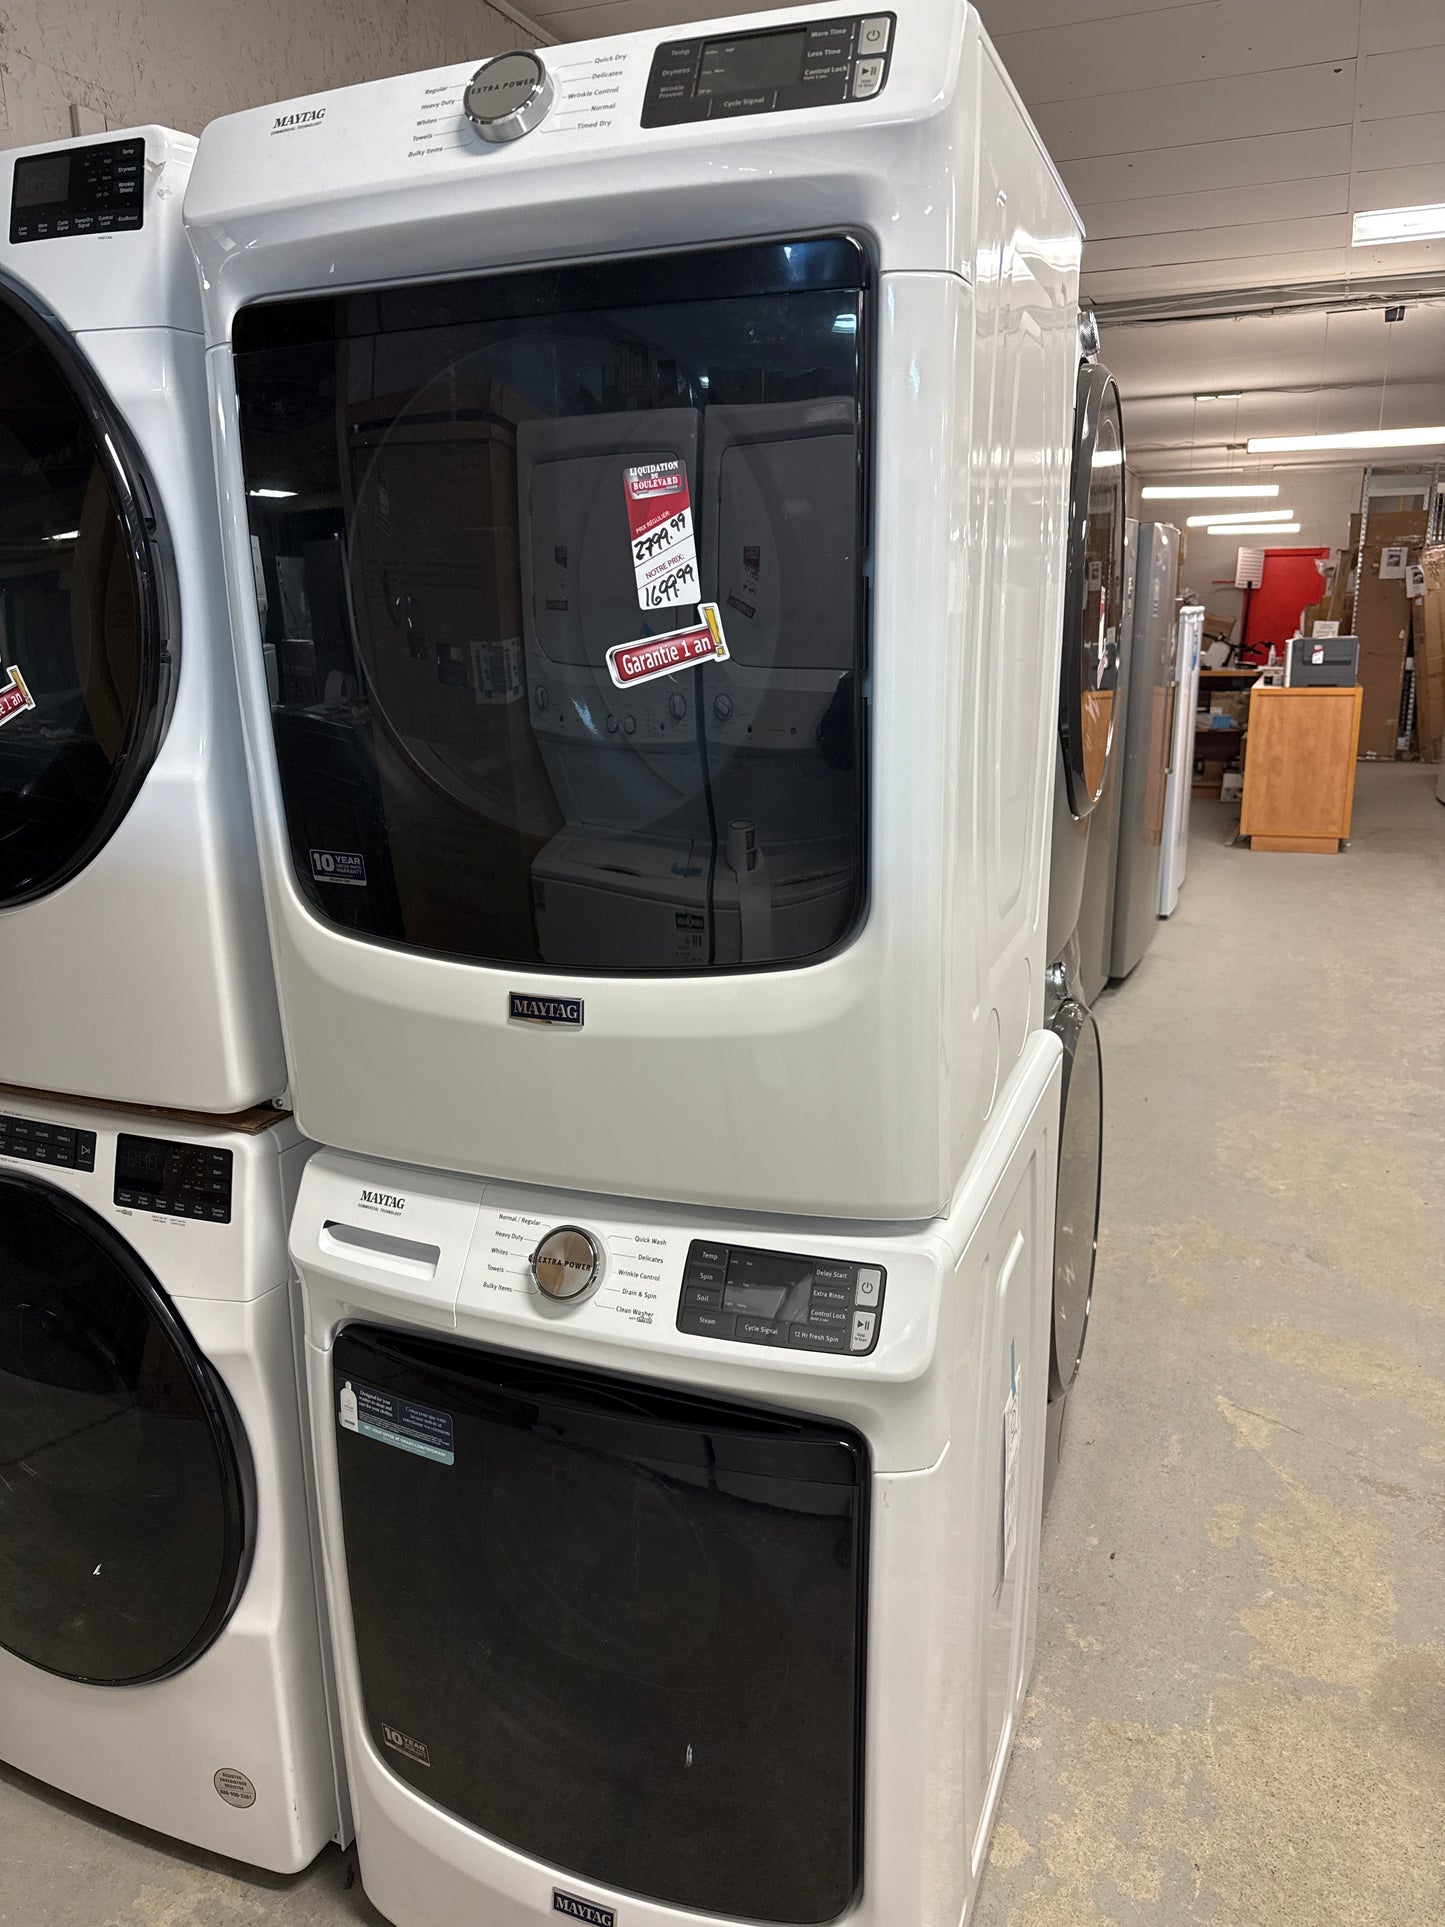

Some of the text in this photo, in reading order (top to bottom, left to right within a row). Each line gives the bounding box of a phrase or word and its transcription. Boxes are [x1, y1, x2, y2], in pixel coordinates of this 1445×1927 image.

[810, 27, 847, 38] More Time
[671, 48, 690, 58] Temp
[826, 48, 841, 56] Time
[594, 53, 628, 65] Quick Dry
[592, 70, 623, 80] Delicates
[661, 66, 690, 78] Dryness
[804, 65, 848, 76] Control Lock
[425, 86, 448, 96] Regular
[471, 78, 536, 96] EXTRA POWER
[567, 86, 619, 100] Wrinkle Control
[660, 84, 685, 93] Wrinkle
[658, 90, 684, 100] Prevent
[421, 98, 456, 111] Heavy Duty
[590, 102, 616, 112] Normal
[723, 96, 765, 108] Cycle Signal
[272, 108, 326, 129] MAYTAG
[416, 117, 438, 127] Whites
[577, 118, 612, 130] Timed Dry
[412, 132, 434, 142] Towels
[408, 146, 444, 159] Bulky Items
[117, 165, 136, 174] Dryness
[629, 461, 678, 476] LIQUIDATION
[633, 476, 679, 491] BOULEVARD
[635, 522, 647, 534] PRIX
[634, 512, 686, 560] 2799.99
[645, 553, 685, 579] NOTRE PRIX:
[645, 564, 694, 607] 1699.99
[622, 646, 680, 676] Garantie
[681, 640, 692, 657] 1
[4, 692, 23, 710] 1 an
[314, 853, 361, 872] 10 YEAR
[513, 1000, 578, 1018] MAYTAG
[360, 1190, 406, 1210] MAYTAG
[358, 1203, 402, 1216] COMMERCIAL TECHNOLOGY
[498, 1214, 517, 1223] Normal
[521, 1218, 542, 1226] Regular
[495, 1230, 524, 1242] Heavy Duty
[634, 1235, 666, 1246] Quick Wash
[491, 1248, 509, 1256] Whites
[702, 1252, 718, 1261] Temp
[538, 1256, 592, 1272] EXTRA POWER
[638, 1254, 664, 1264] Delicates
[487, 1264, 504, 1273] Towels
[816, 1268, 848, 1280] Delay Start
[618, 1269, 661, 1282] Wrinkle Control
[700, 1272, 714, 1282] Spin
[482, 1282, 513, 1293] Bulky Items
[622, 1288, 637, 1296] Drain
[644, 1292, 656, 1300] Spin
[696, 1294, 709, 1302] Soil
[813, 1290, 845, 1300] Extra Rinse
[616, 1306, 654, 1317] Clean Washer
[810, 1310, 832, 1318] Control
[699, 1316, 716, 1326] Steam
[744, 1324, 779, 1336] Cycle Signal
[810, 1332, 824, 1340] Fresh
[826, 1335, 839, 1344] Spin
[382, 1432, 395, 1440] OFFER
[384, 1726, 402, 1746] 10
[402, 1736, 425, 1752] YEAR
[556, 1896, 612, 1927] MAYTAG
